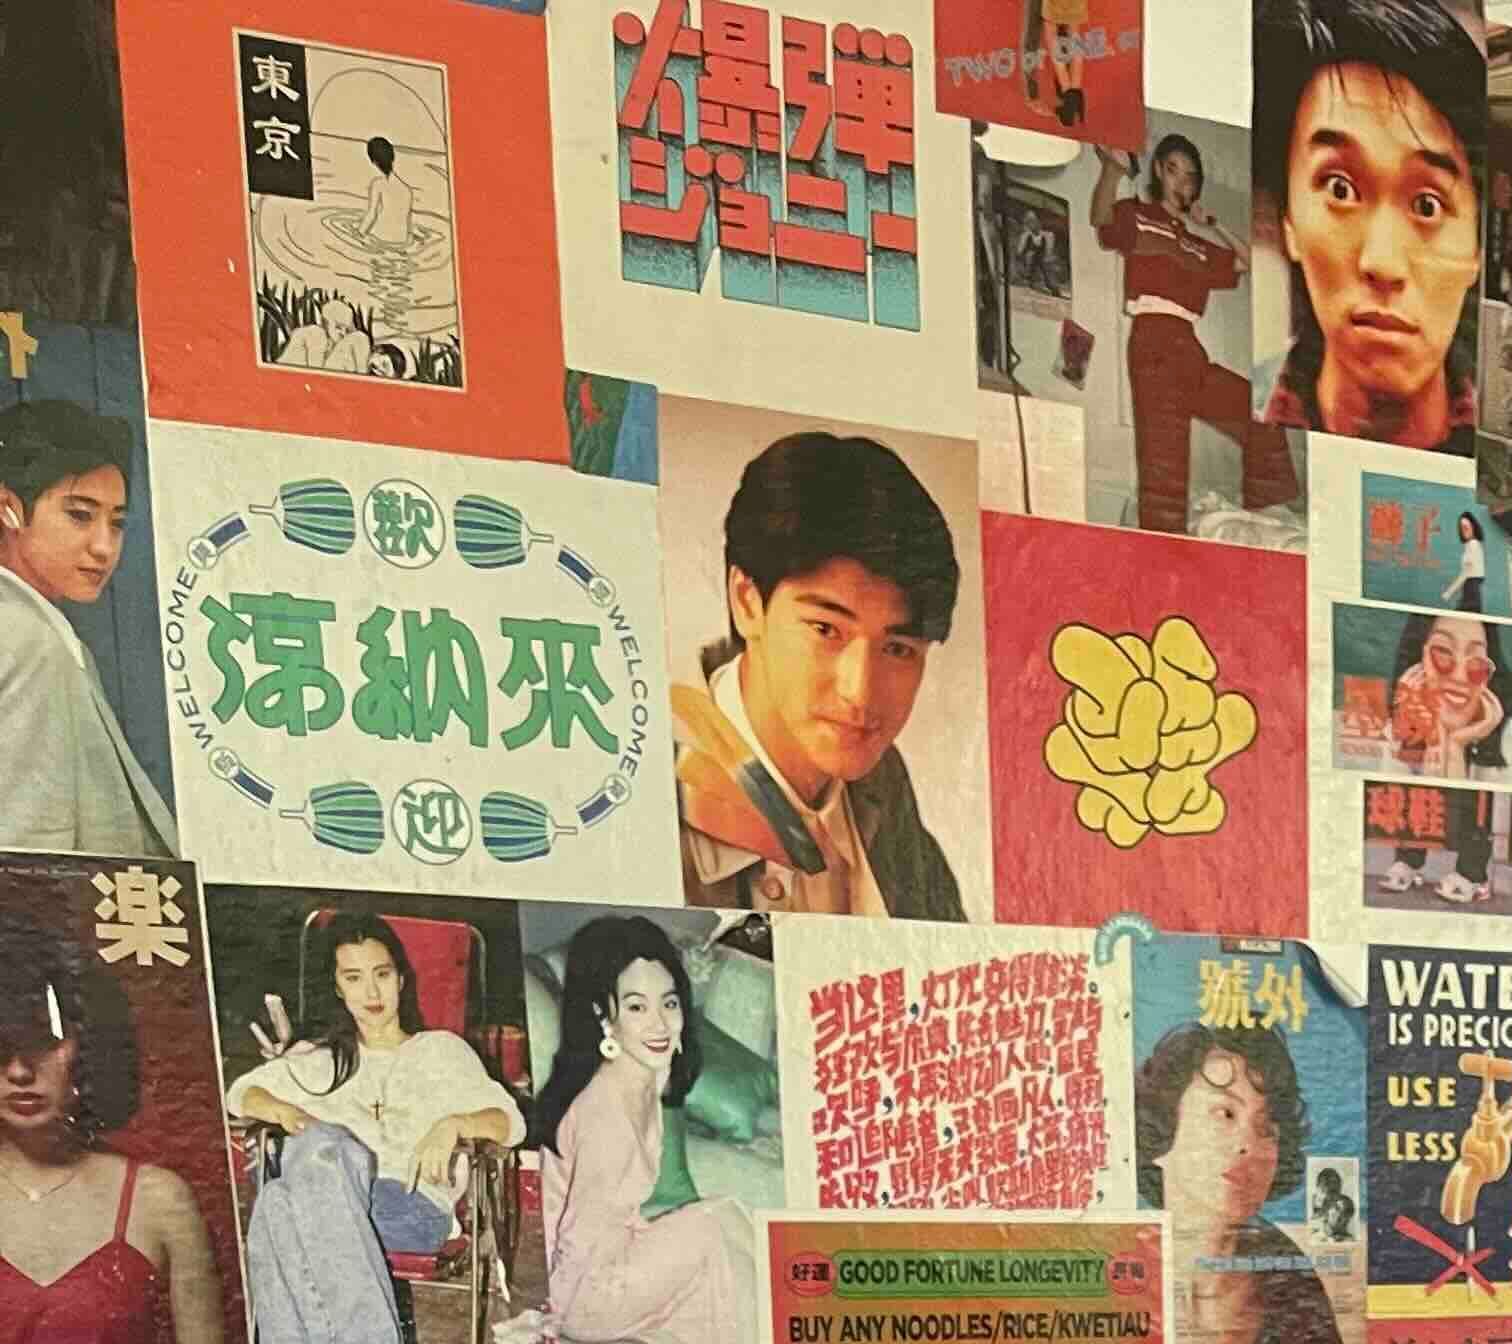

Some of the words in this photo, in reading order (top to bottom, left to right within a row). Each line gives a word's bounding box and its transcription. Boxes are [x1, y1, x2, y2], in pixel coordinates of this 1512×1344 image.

[250, 52, 304, 163] 東京
[165, 566, 213, 749] WELCOME
[608, 605, 649, 777] WELCOME
[90, 865, 193, 967] 楽
[1388, 1017, 1412, 1047] IS
[1387, 1076, 1457, 1108] USE
[1387, 1131, 1457, 1163] LESS
[839, 1259, 899, 1285] GOOD
[904, 1259, 995, 1285] FORTUNE
[1000, 1259, 1104, 1285] LONGEVITY
[789, 1315, 833, 1343] BUY
[840, 1314, 885, 1342] ANY
